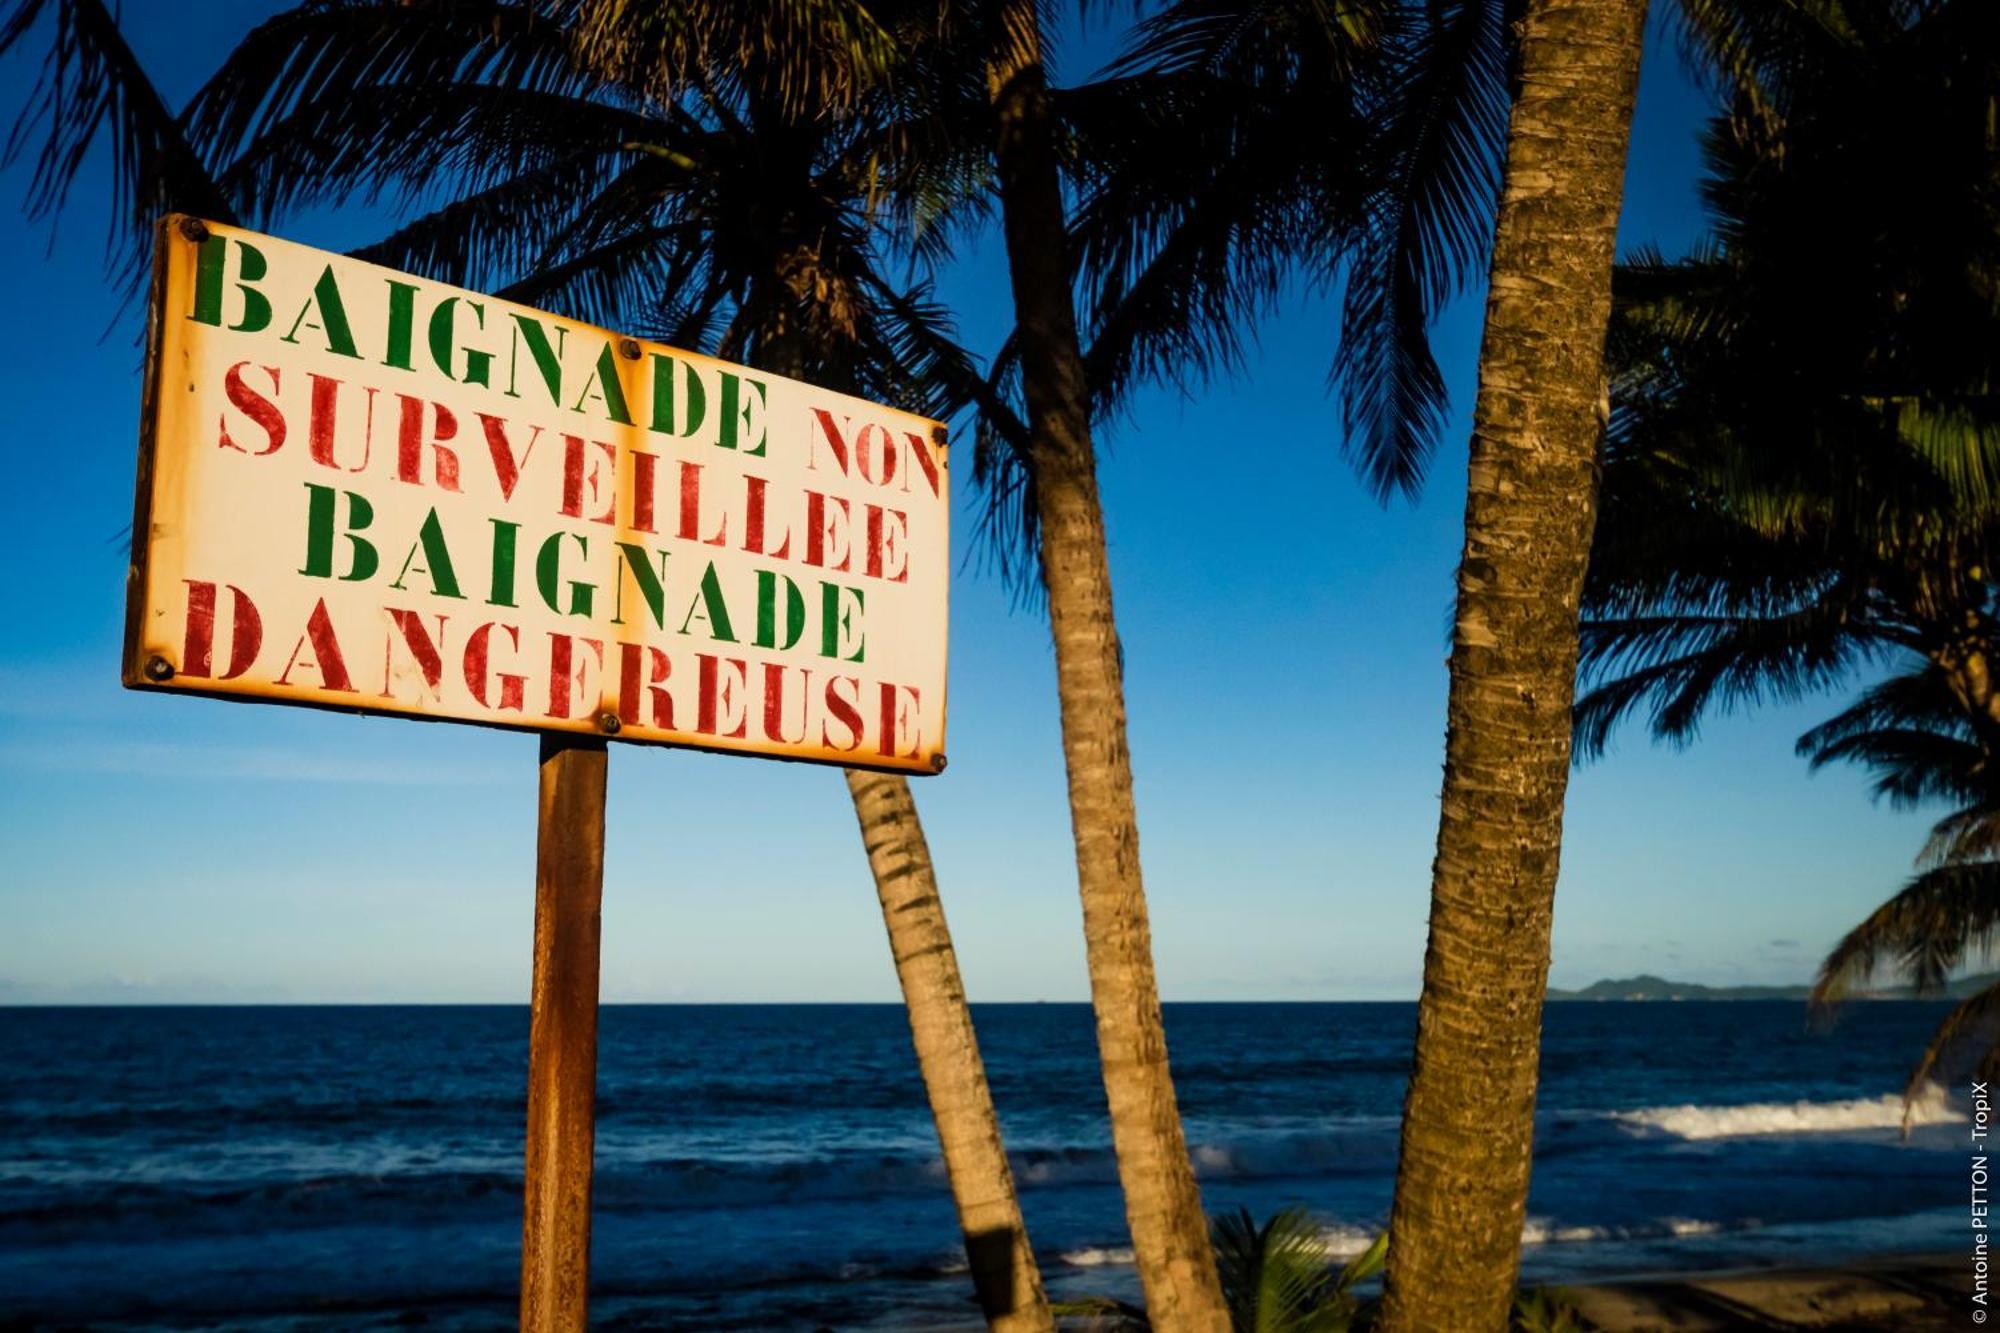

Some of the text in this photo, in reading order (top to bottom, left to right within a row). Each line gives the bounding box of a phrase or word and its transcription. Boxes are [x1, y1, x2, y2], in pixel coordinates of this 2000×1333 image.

[187, 235, 942, 500] BAIGNADE NON
[218, 360, 910, 584] SURVEILLEE
[298, 482, 867, 664] BAIGNADE
[176, 578, 922, 760] DANGEREUSE
